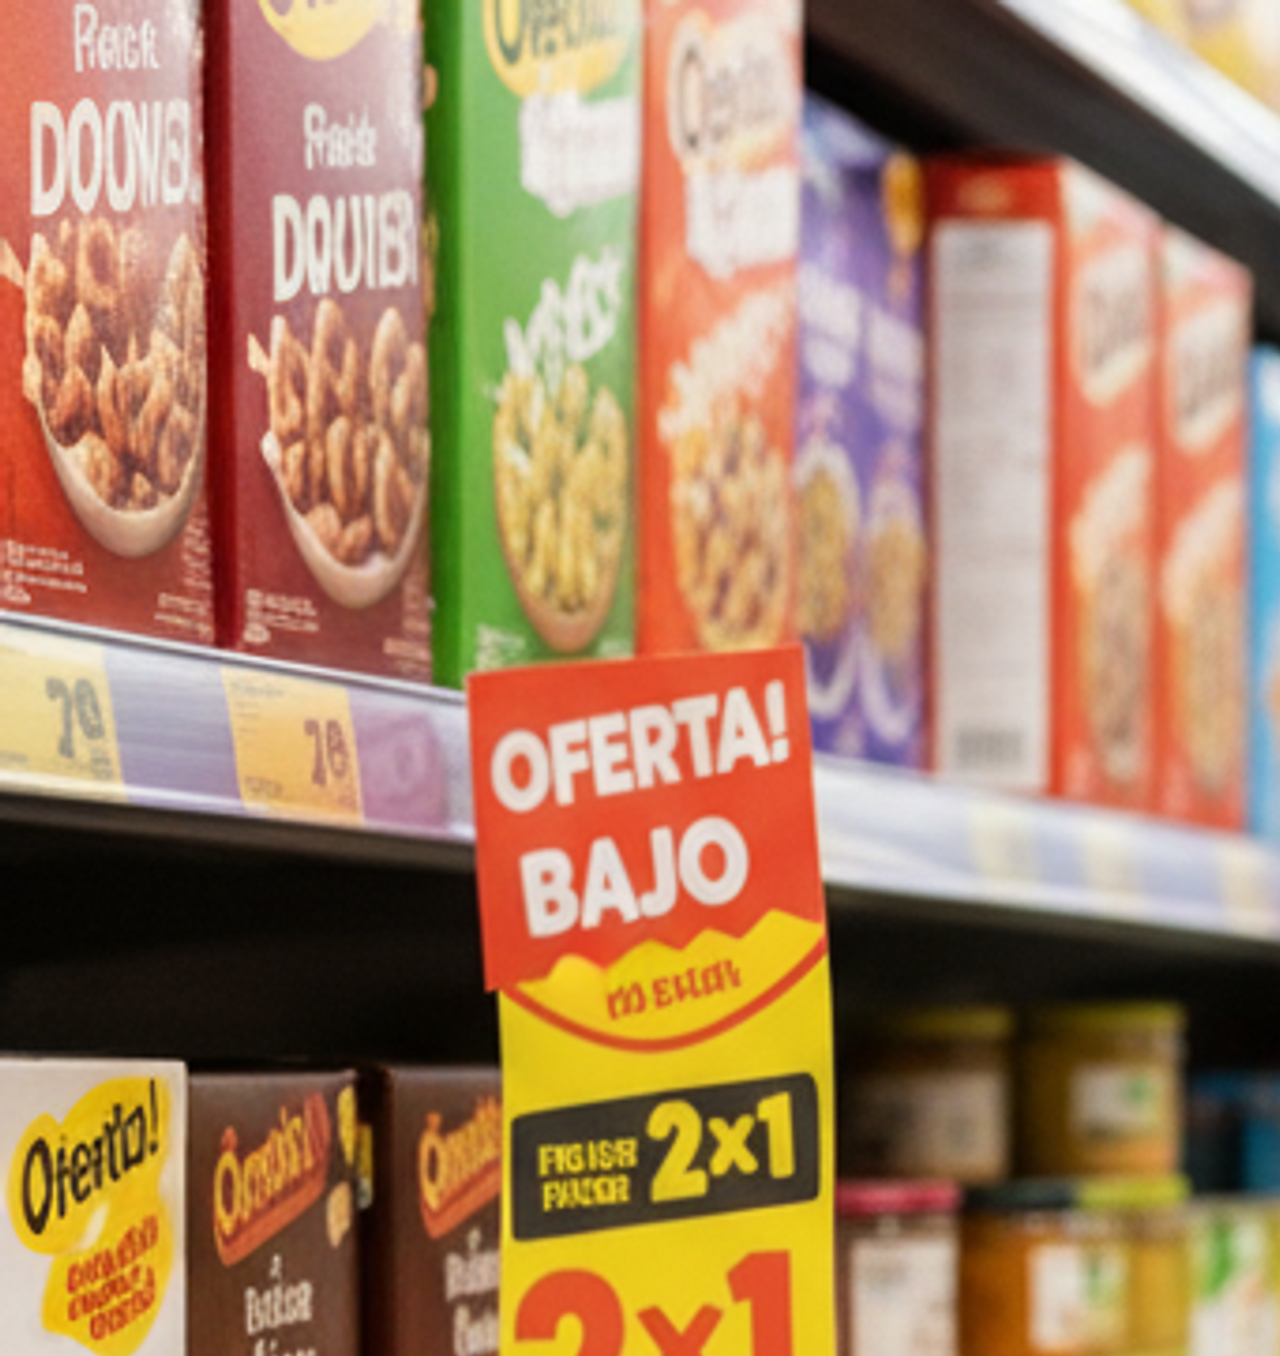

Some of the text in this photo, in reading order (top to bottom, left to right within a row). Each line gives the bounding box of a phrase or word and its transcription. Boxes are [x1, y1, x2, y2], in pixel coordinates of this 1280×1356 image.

[490, 679, 790, 812] OFERTA!
[519, 816, 749, 938] BAJO
[646, 1092, 795, 1204] 2x1
